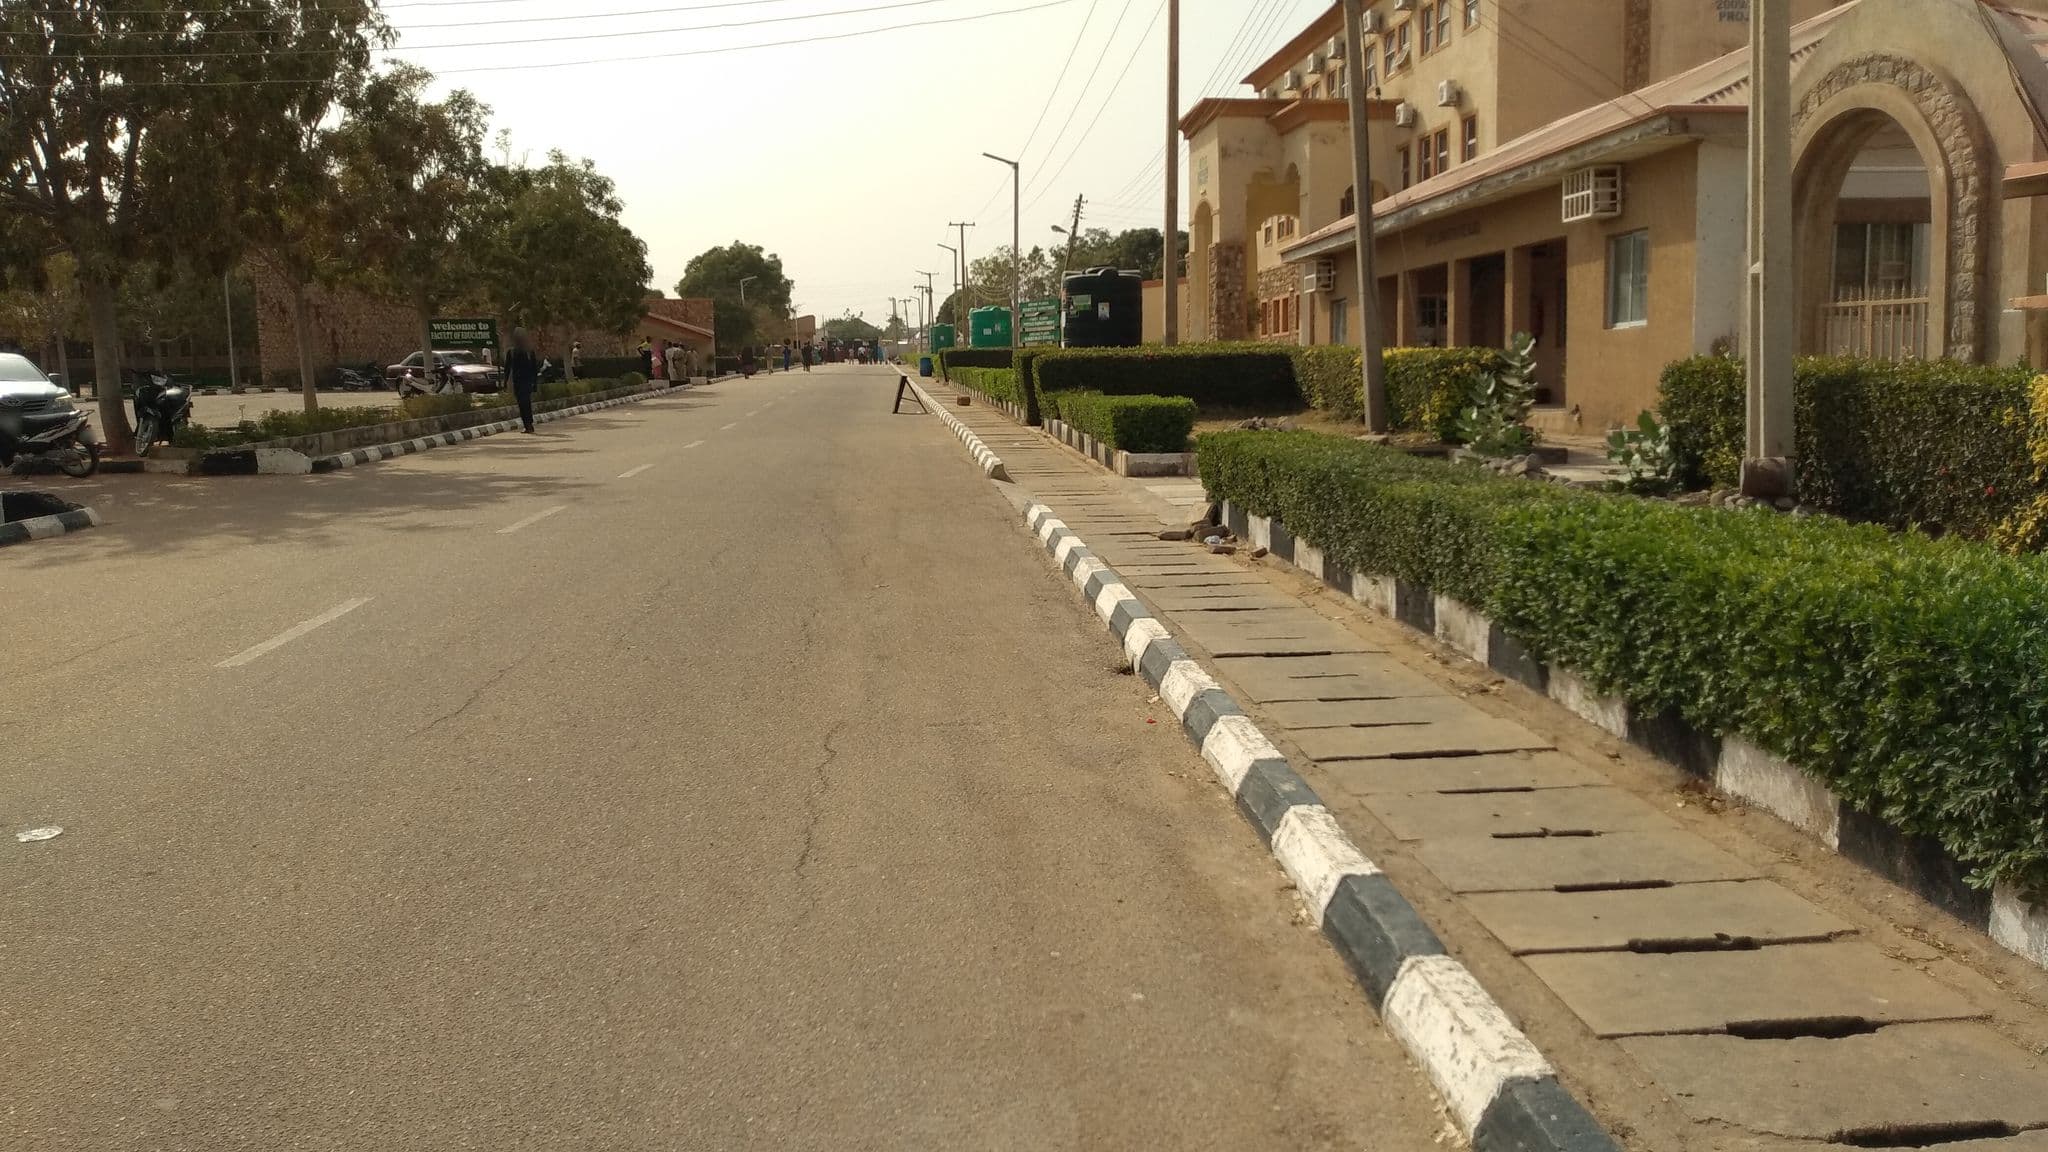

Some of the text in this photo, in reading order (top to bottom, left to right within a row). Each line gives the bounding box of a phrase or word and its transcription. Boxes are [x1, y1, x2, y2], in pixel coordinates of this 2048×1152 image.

[432, 321, 489, 330] welcome to
[431, 331, 453, 339] FACULTY
[454, 331, 461, 339] OF
